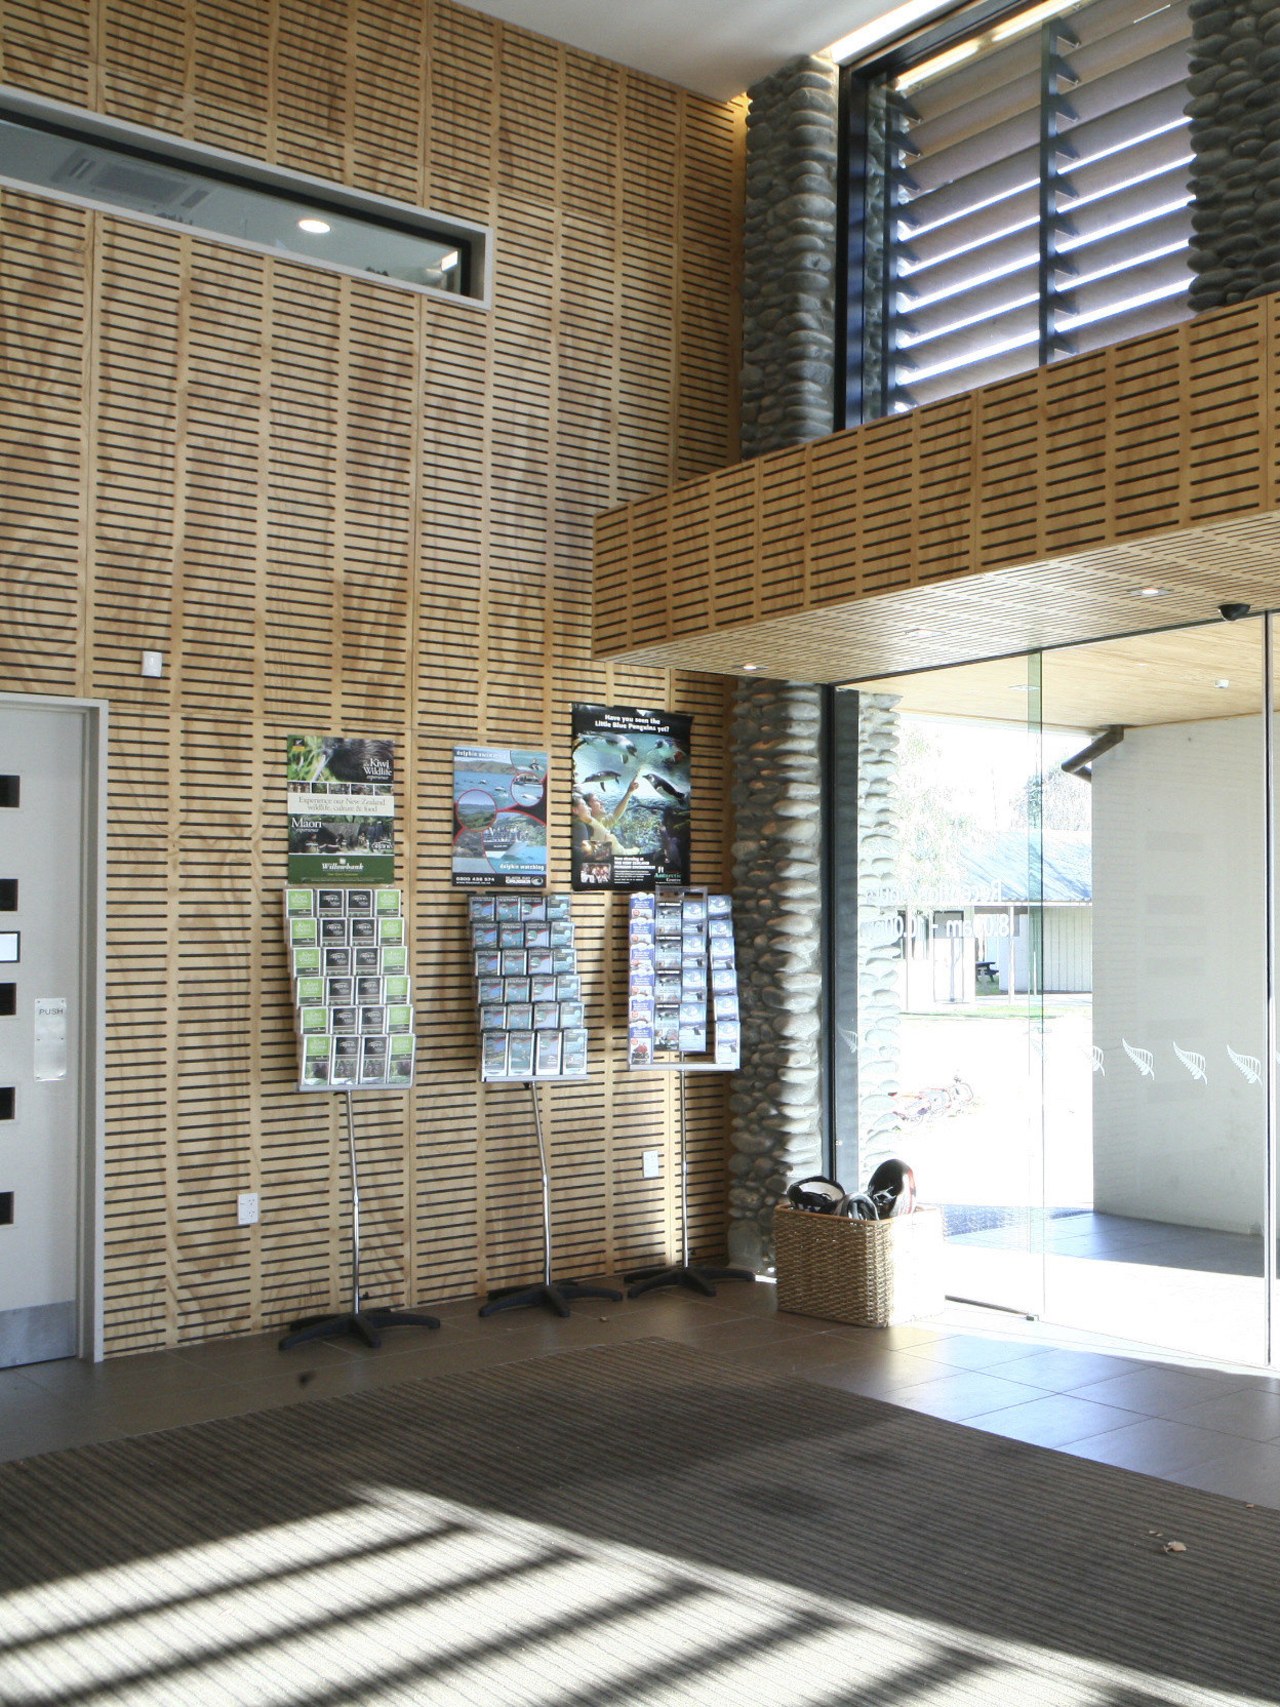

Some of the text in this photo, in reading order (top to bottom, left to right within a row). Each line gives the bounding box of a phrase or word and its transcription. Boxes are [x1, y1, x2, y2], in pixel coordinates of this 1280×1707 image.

[604, 714, 621, 722] Have
[595, 720, 612, 728] Little
[612, 721, 627, 729] Blue
[628, 723, 657, 732] Penguins
[370, 758, 389, 768] Kiwi
[363, 766, 392, 776] Wildlife
[298, 796, 332, 806] Experience
[361, 798, 386, 807] Zealand
[291, 817, 322, 828] Maori
[322, 862, 364, 870] Willowbank
[520, 864, 545, 872] watching
